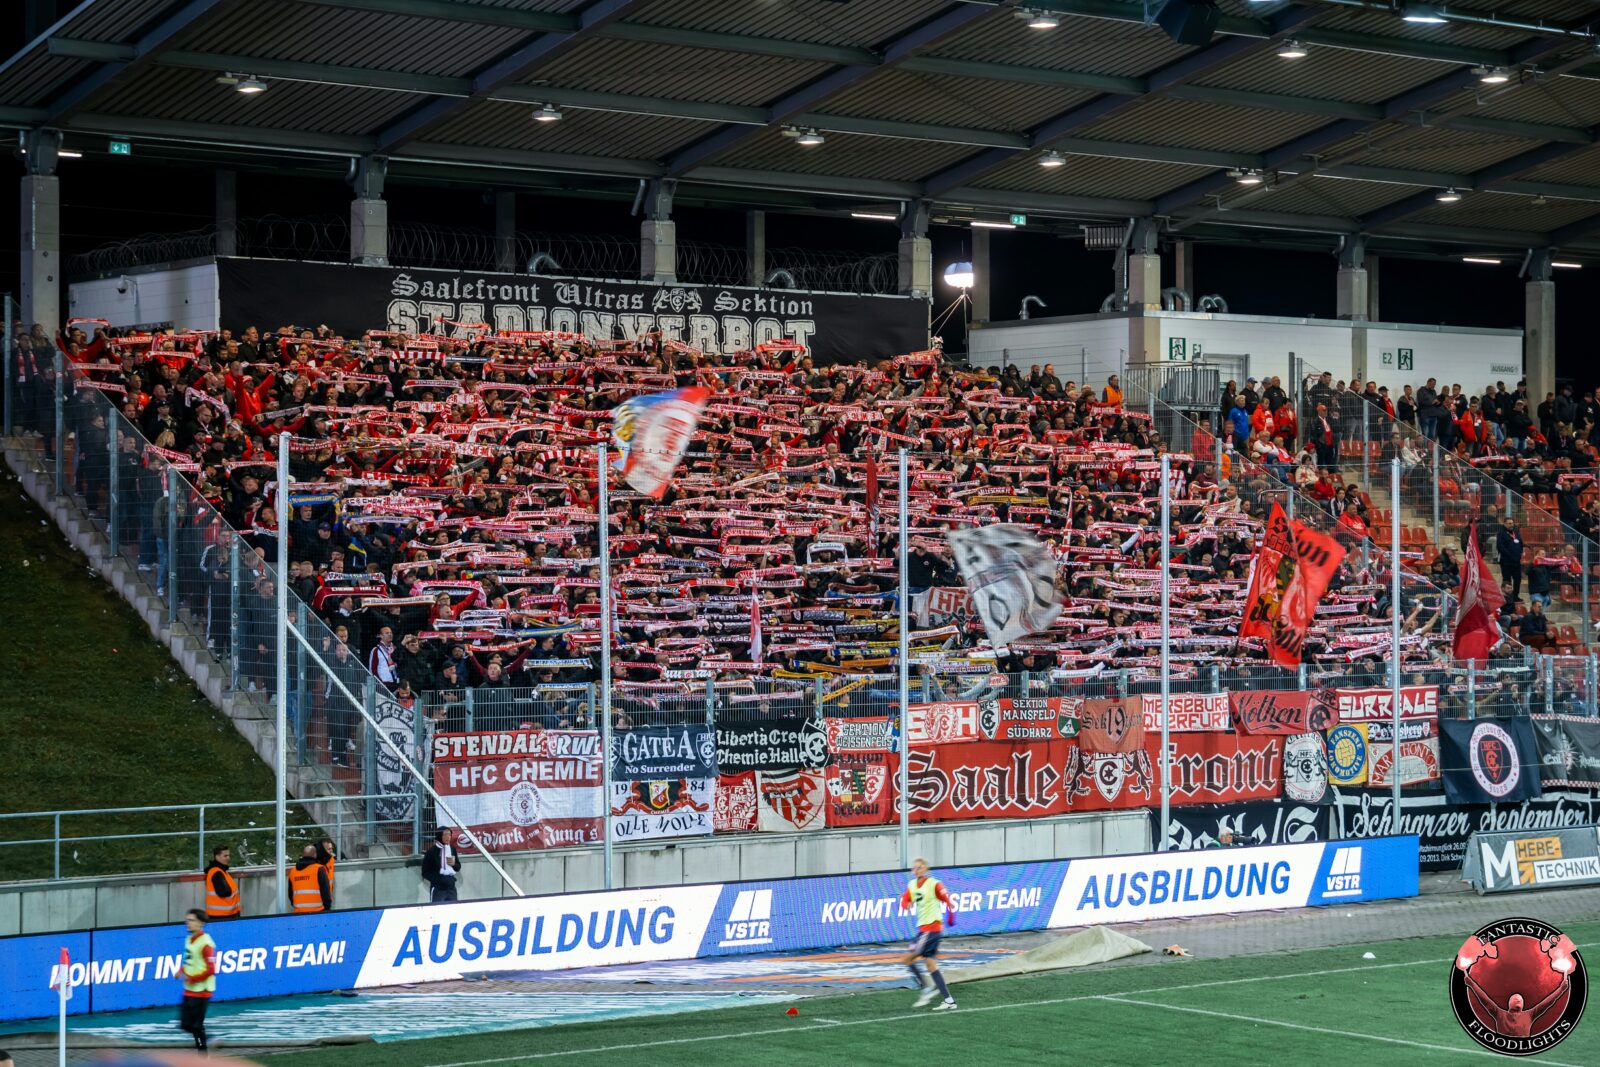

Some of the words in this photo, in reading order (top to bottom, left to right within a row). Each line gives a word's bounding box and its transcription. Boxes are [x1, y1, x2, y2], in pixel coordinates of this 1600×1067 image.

[391, 273, 540, 301] Saalefront
[553, 281, 644, 310] Ultras
[713, 291, 813, 316] Sektion
[386, 299, 816, 360] STADIONVERBOT
[1382, 352, 1393, 364] E2
[938, 592, 976, 616] HFC
[980, 701, 994, 711] HFC
[1002, 708, 1057, 721] MANSFELD
[1012, 698, 1048, 709] SEKTION
[1232, 692, 1302, 725] Köthen
[1338, 690, 1437, 719] SURRALE
[843, 722, 886, 736] SEKTION
[1006, 723, 1052, 739] SÜDHARZ
[1331, 729, 1364, 749] FANSZENE
[434, 733, 543, 758] STENDAL
[623, 732, 676, 763] GATE
[836, 735, 893, 748] WEISSENFELS
[716, 748, 768, 765] Chemie
[768, 746, 808, 764] Halle
[1327, 749, 1363, 777] LOKOMOTIVE
[449, 764, 497, 788] HFC
[504, 759, 599, 782] CHEMIE
[625, 765, 639, 774] No
[640, 763, 696, 774] Surrender
[866, 766, 882, 775] HFC
[893, 750, 1061, 813] Saale
[1158, 738, 1280, 797] front
[615, 783, 628, 795] 19
[690, 780, 705, 792] 84
[615, 815, 650, 837] OLLE
[1481, 840, 1521, 888] M
[1518, 840, 1560, 858] HEBE-
[1537, 859, 1599, 879] TECHNIK
[1076, 860, 1291, 911] AUSBILDUNG
[1326, 874, 1361, 891] VSTR
[821, 898, 896, 924] KOMMT
[986, 887, 1041, 910] TEAM!
[392, 905, 676, 968] AUSBILDUNG
[723, 920, 771, 940] VSTR
[155, 954, 183, 980] IN
[273, 940, 346, 968] TEAM!
